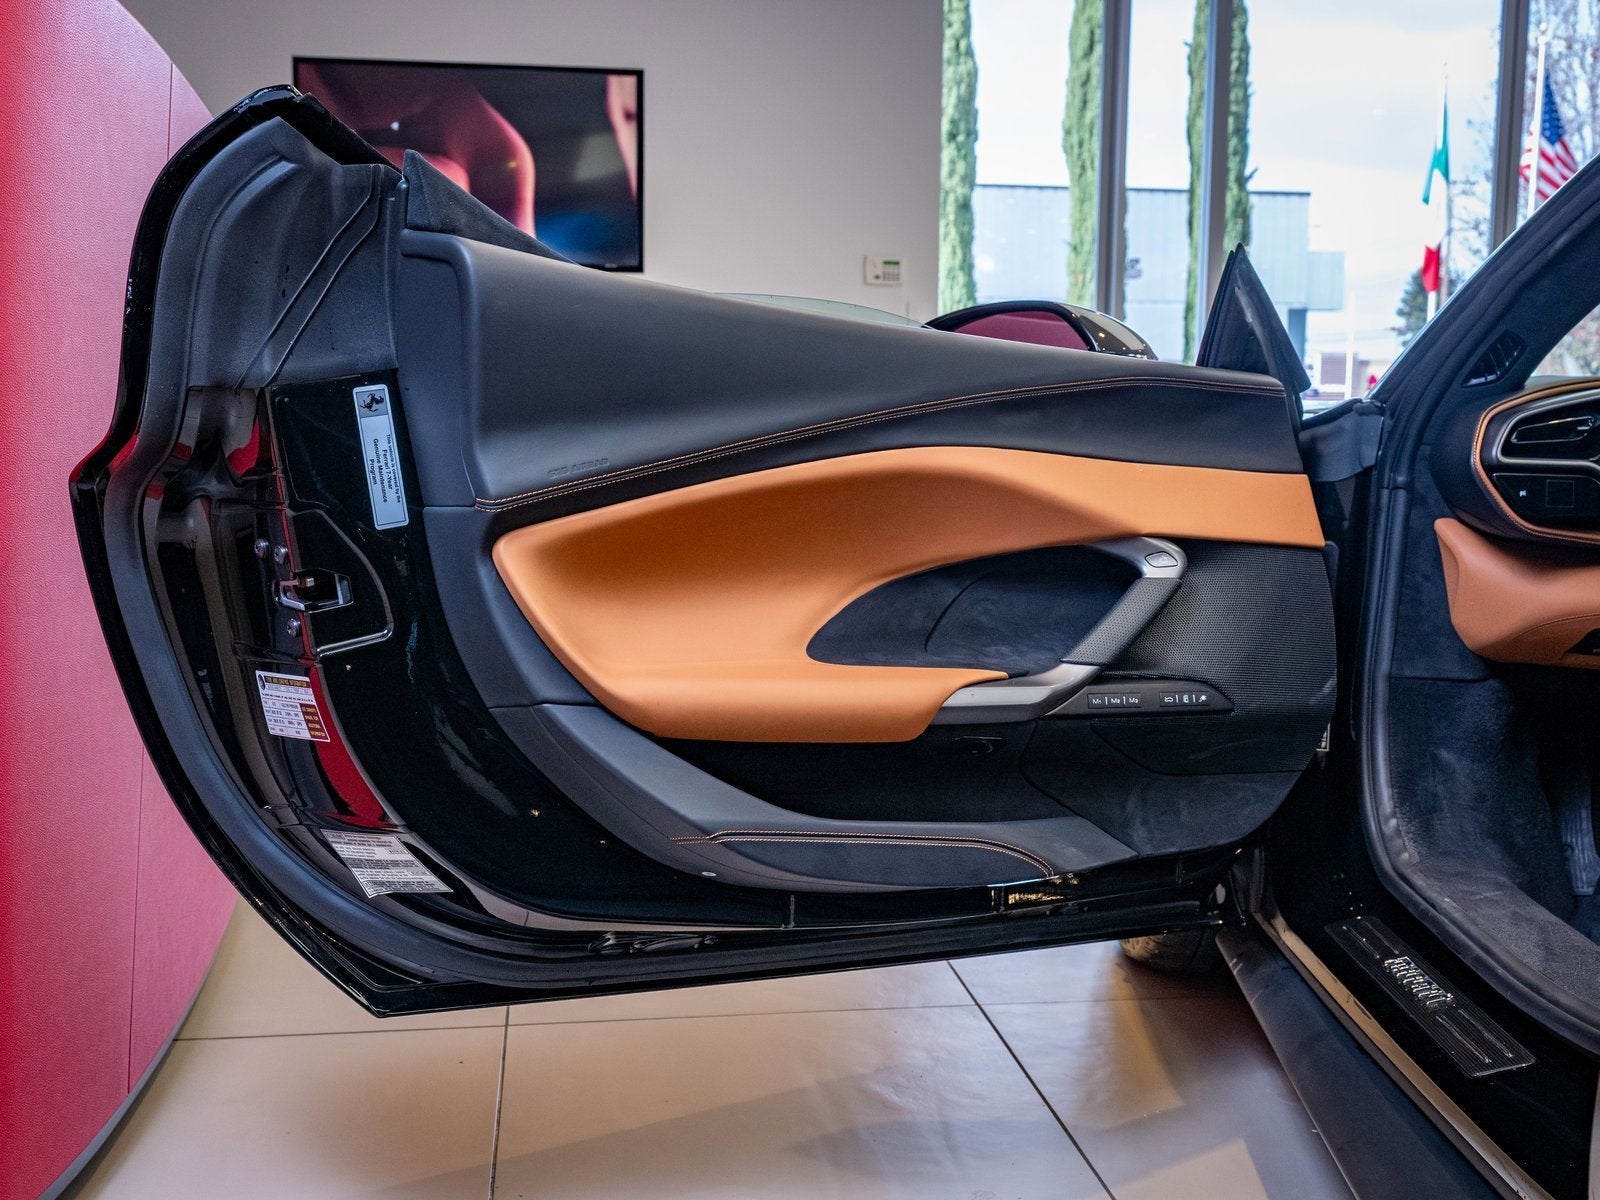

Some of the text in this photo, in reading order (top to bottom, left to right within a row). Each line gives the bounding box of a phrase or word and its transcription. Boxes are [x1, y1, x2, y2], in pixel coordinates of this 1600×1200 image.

[369, 459, 378, 485] Program
[373, 438, 388, 503] Genuine Maintenance
[382, 449, 393, 490] Ferrari 7-Year
